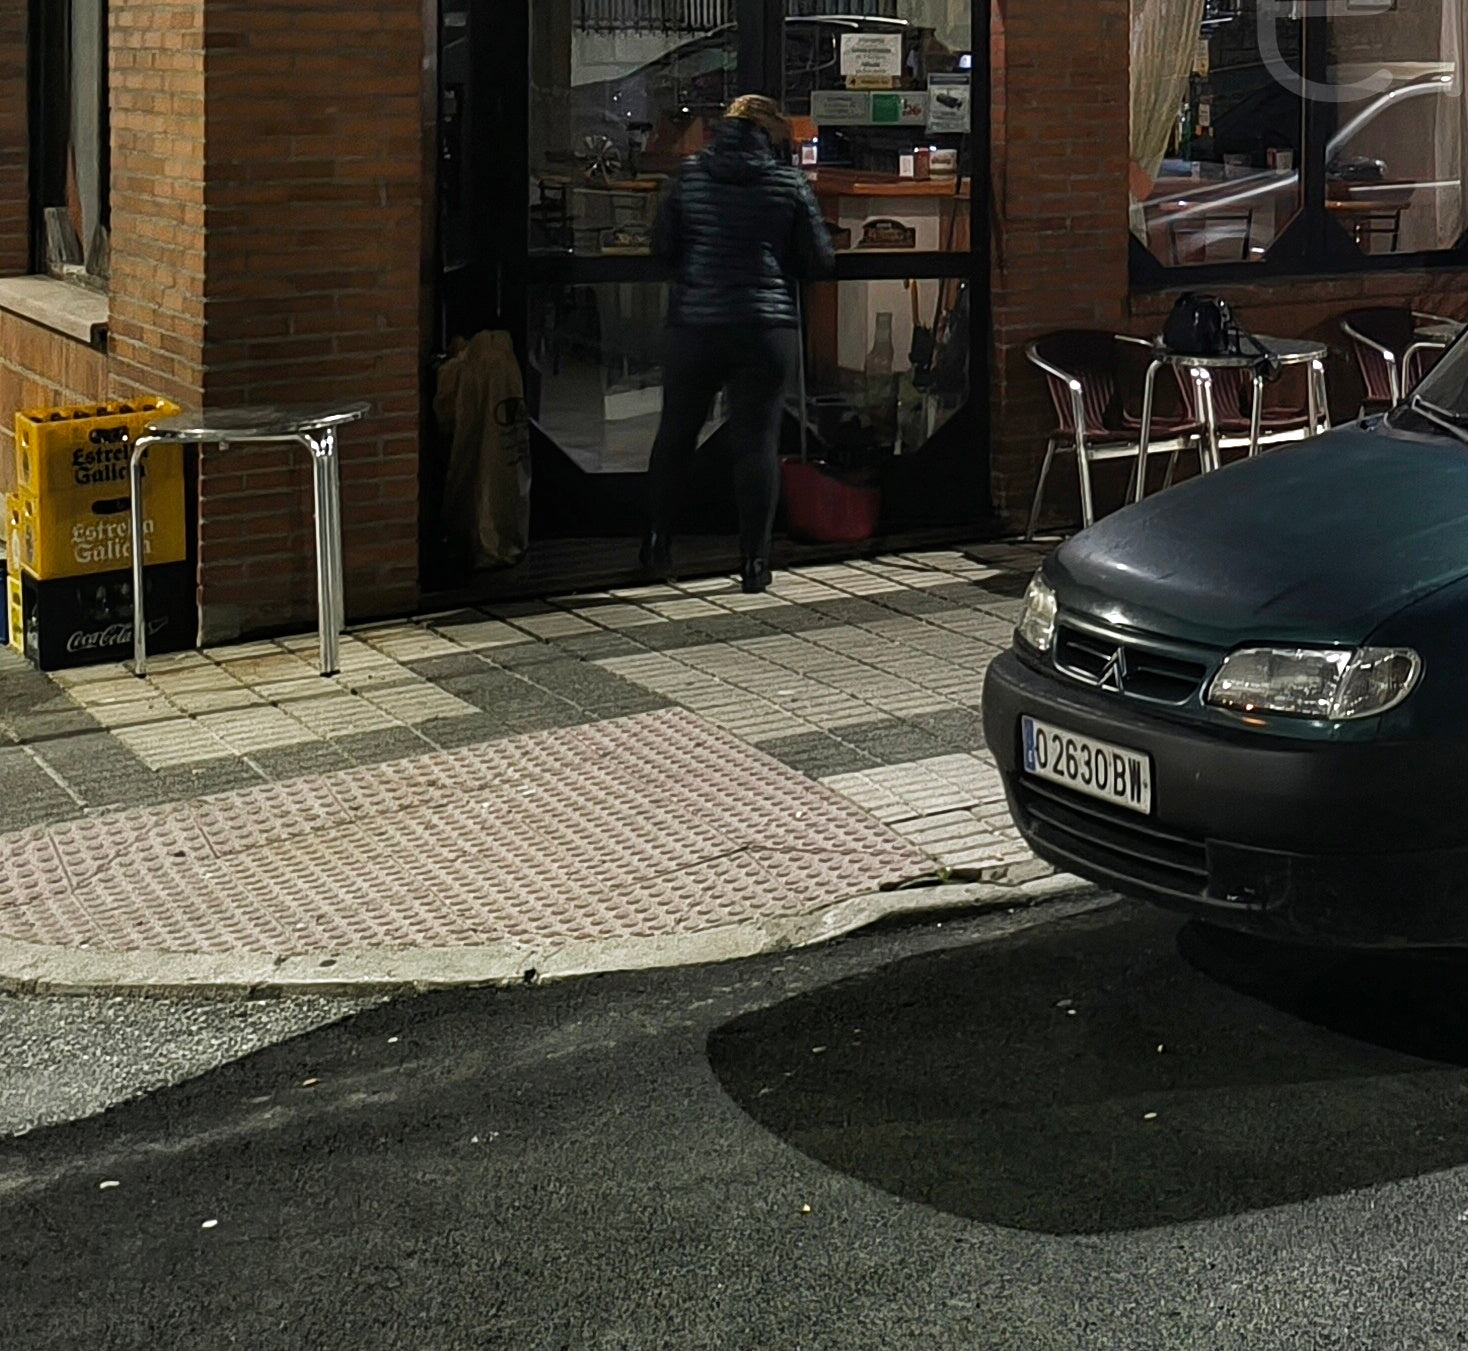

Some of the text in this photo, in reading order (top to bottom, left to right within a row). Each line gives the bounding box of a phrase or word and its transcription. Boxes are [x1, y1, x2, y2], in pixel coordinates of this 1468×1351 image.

[71, 444, 148, 467] Estrela
[73, 461, 147, 485] Galica
[70, 519, 154, 545] Estrela
[73, 537, 152, 564] Galica
